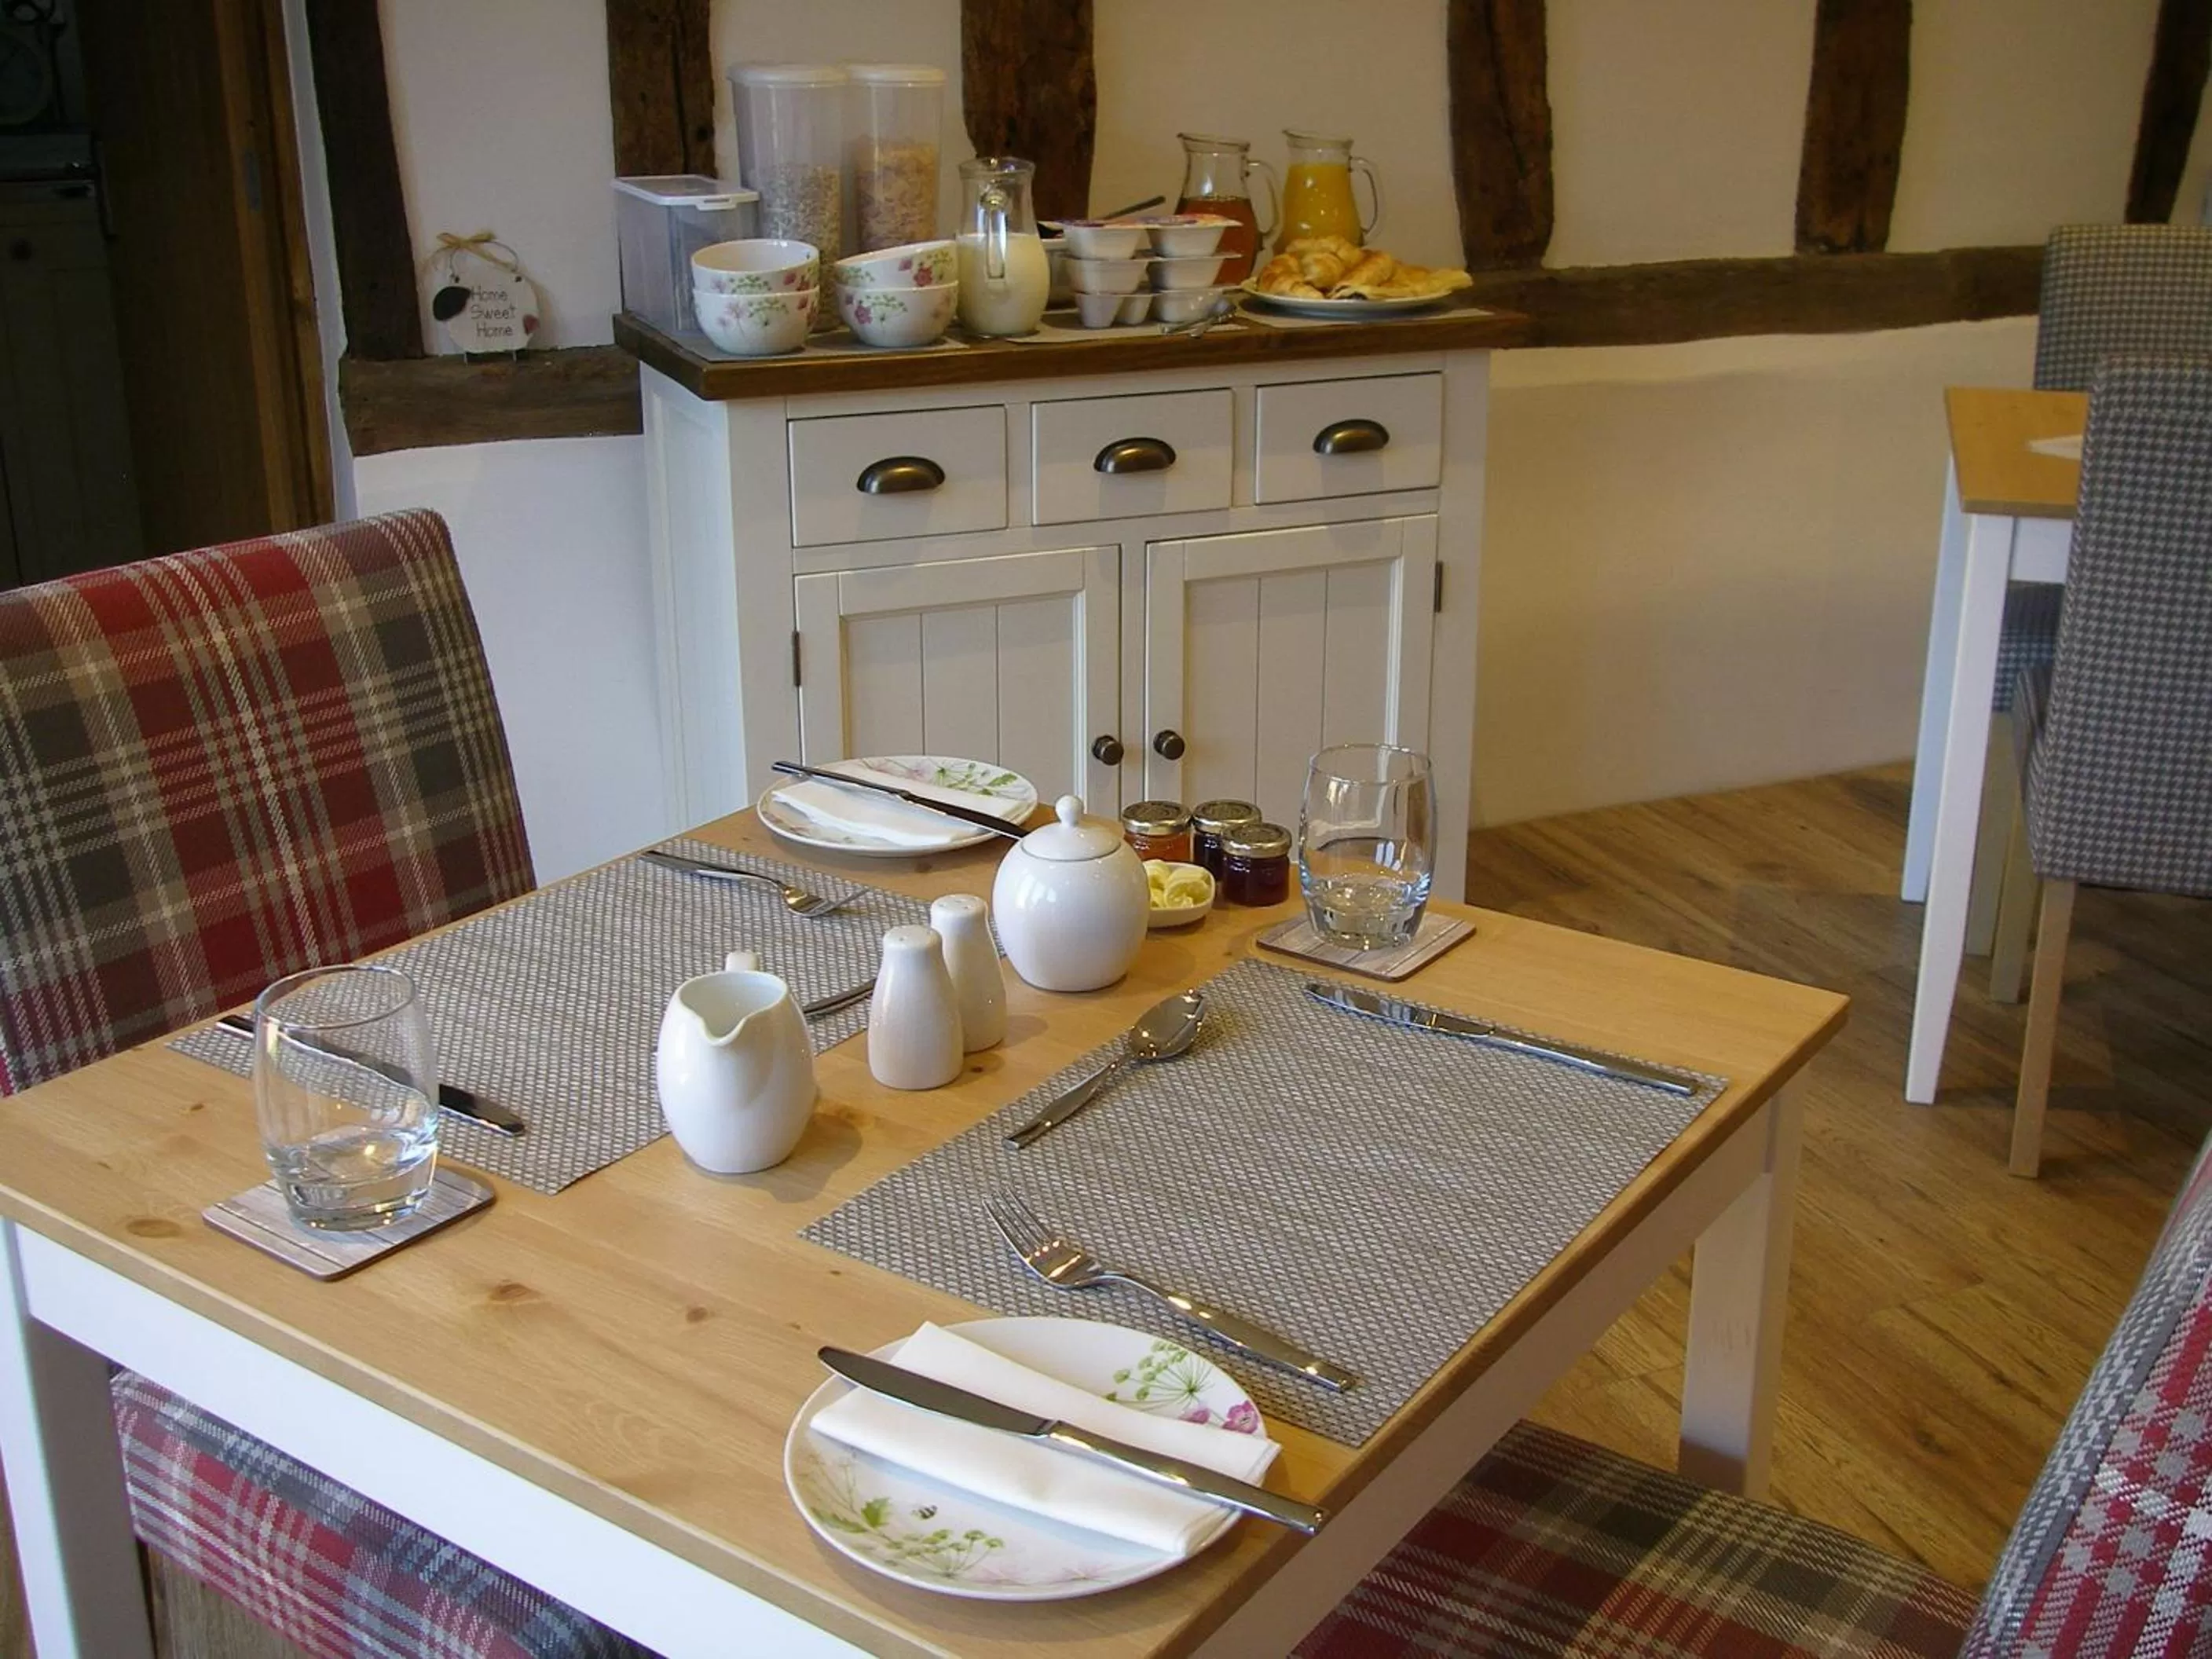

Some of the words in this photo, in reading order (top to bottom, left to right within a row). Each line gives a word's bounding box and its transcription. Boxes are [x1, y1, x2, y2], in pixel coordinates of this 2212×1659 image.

[471, 286, 508, 302] Home
[471, 303, 517, 320] Sweet
[476, 321, 514, 338] Home
